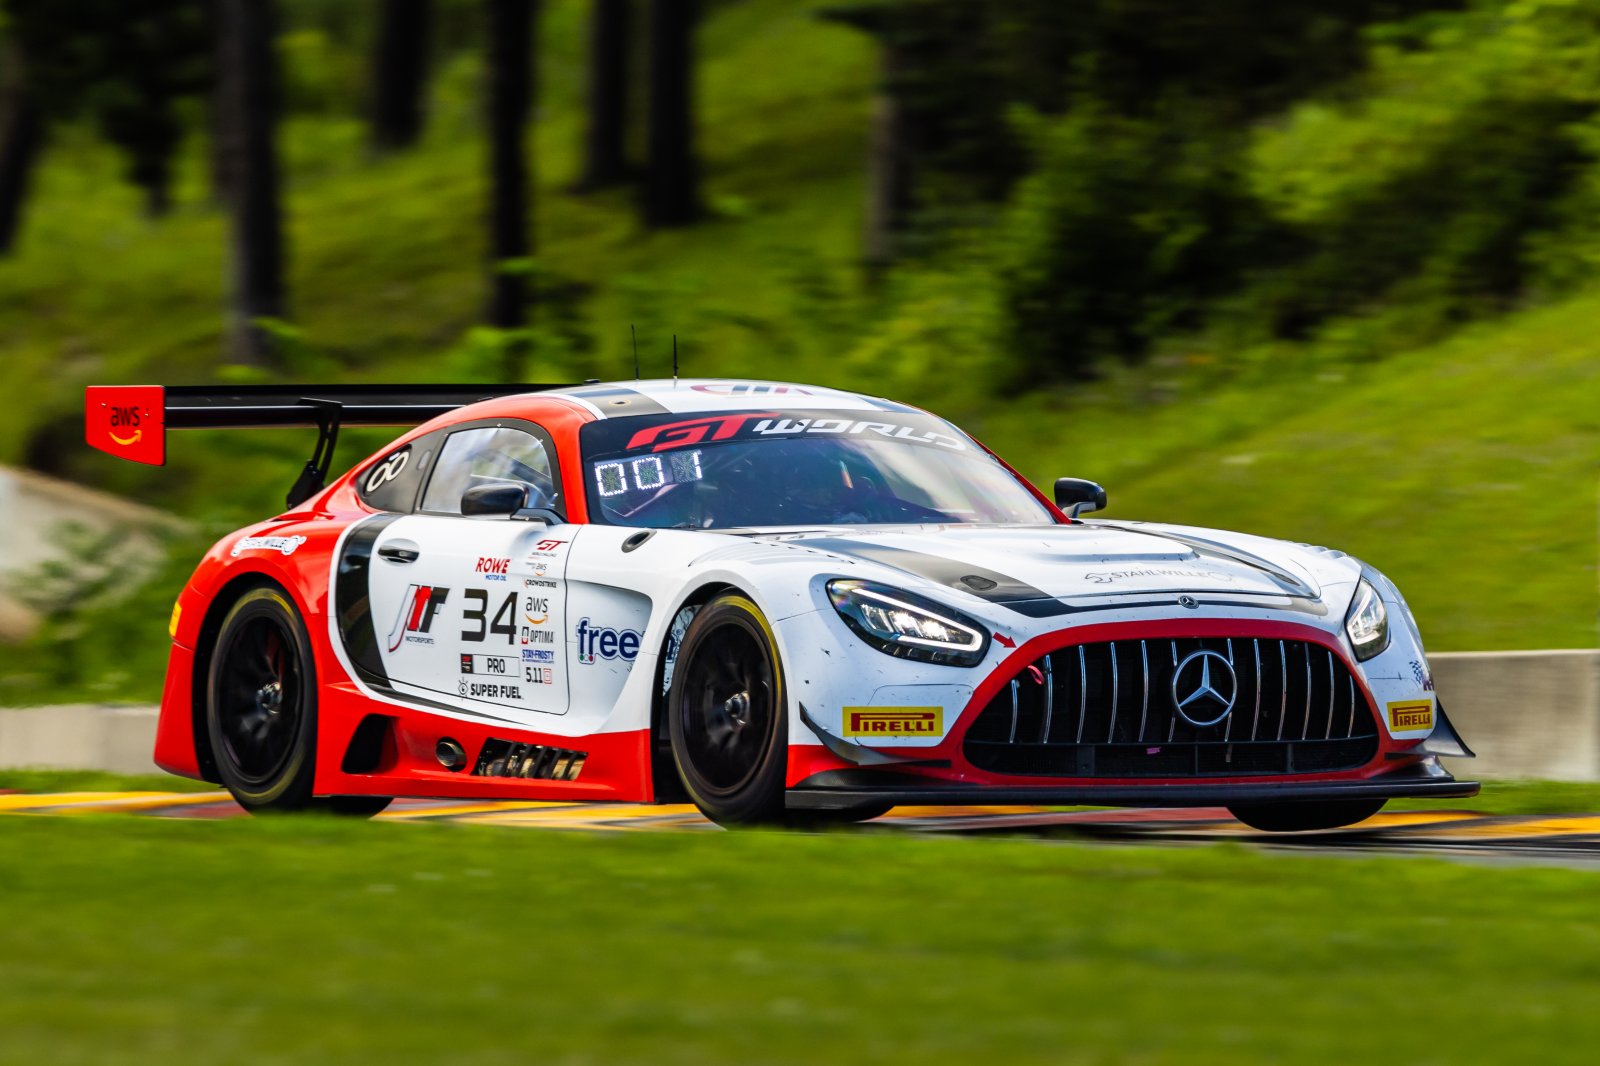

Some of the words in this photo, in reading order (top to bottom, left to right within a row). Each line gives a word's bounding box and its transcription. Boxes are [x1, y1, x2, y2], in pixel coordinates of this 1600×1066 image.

[110, 406, 141, 427] aws
[625, 411, 781, 453] GT
[752, 418, 967, 450] WORLD
[536, 539, 569, 551] GT
[475, 557, 511, 574] ROWE
[1110, 569, 1206, 579] STAHLWILLE
[525, 579, 557, 588] CROWDSTRIKE
[525, 596, 549, 614] aws
[461, 588, 519, 645] 34
[530, 630, 554, 644] OPTIMA
[487, 657, 506, 674] PRO
[525, 666, 543, 684] 5.11
[470, 683, 499, 698] SUPER
[500, 685, 522, 699] FUEL
[850, 712, 936, 732] PIRELLI
[1392, 705, 1431, 727] PIRELLI
